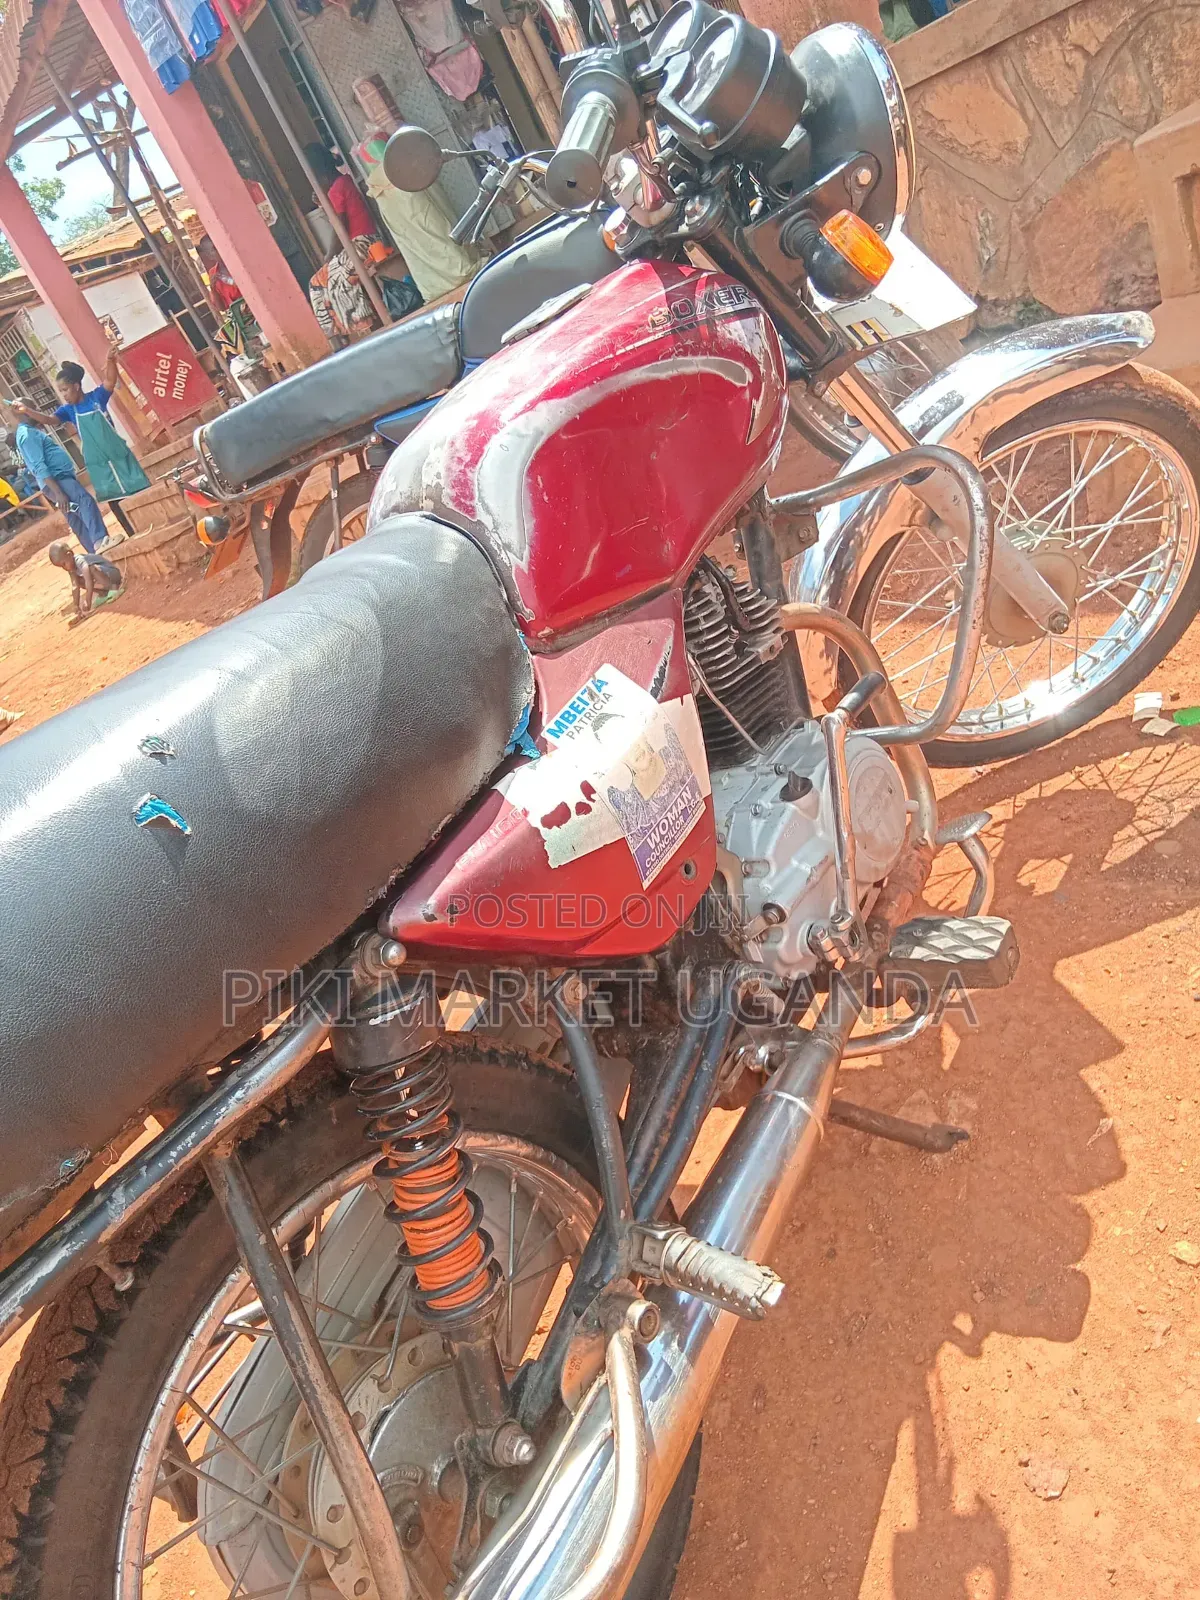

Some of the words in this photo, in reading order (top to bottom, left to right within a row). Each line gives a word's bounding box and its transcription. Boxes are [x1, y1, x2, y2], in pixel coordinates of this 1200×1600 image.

[648, 284, 753, 331] BOXER
[151, 352, 172, 398] airtel
[171, 359, 193, 400] money
[566, 692, 613, 740] PATRICIA
[645, 814, 685, 868] COUNCILLOR
[646, 787, 692, 850] WOMAN
